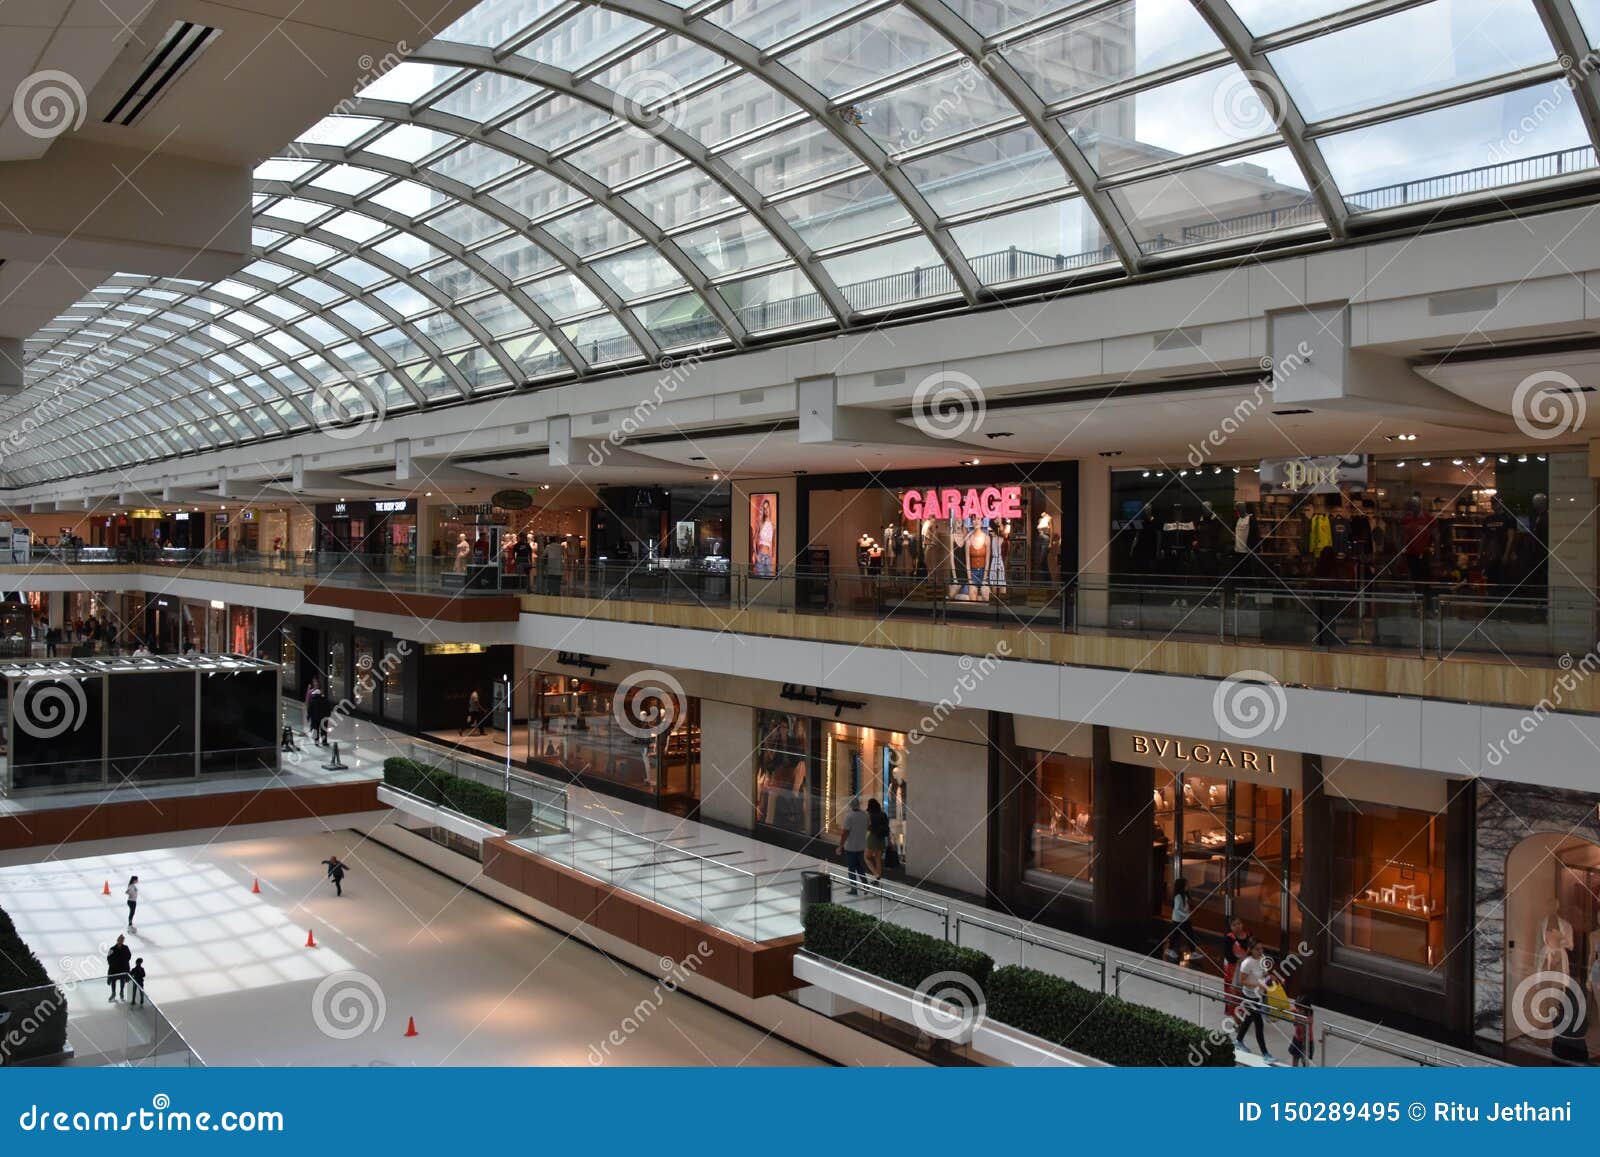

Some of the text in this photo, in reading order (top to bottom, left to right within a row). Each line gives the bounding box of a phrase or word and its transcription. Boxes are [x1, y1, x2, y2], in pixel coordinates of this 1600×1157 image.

[375, 502, 384, 511] THE
[394, 501, 407, 511] SHOP
[902, 485, 1023, 520] GARAGE
[1133, 734, 1278, 774] BVLGARI
